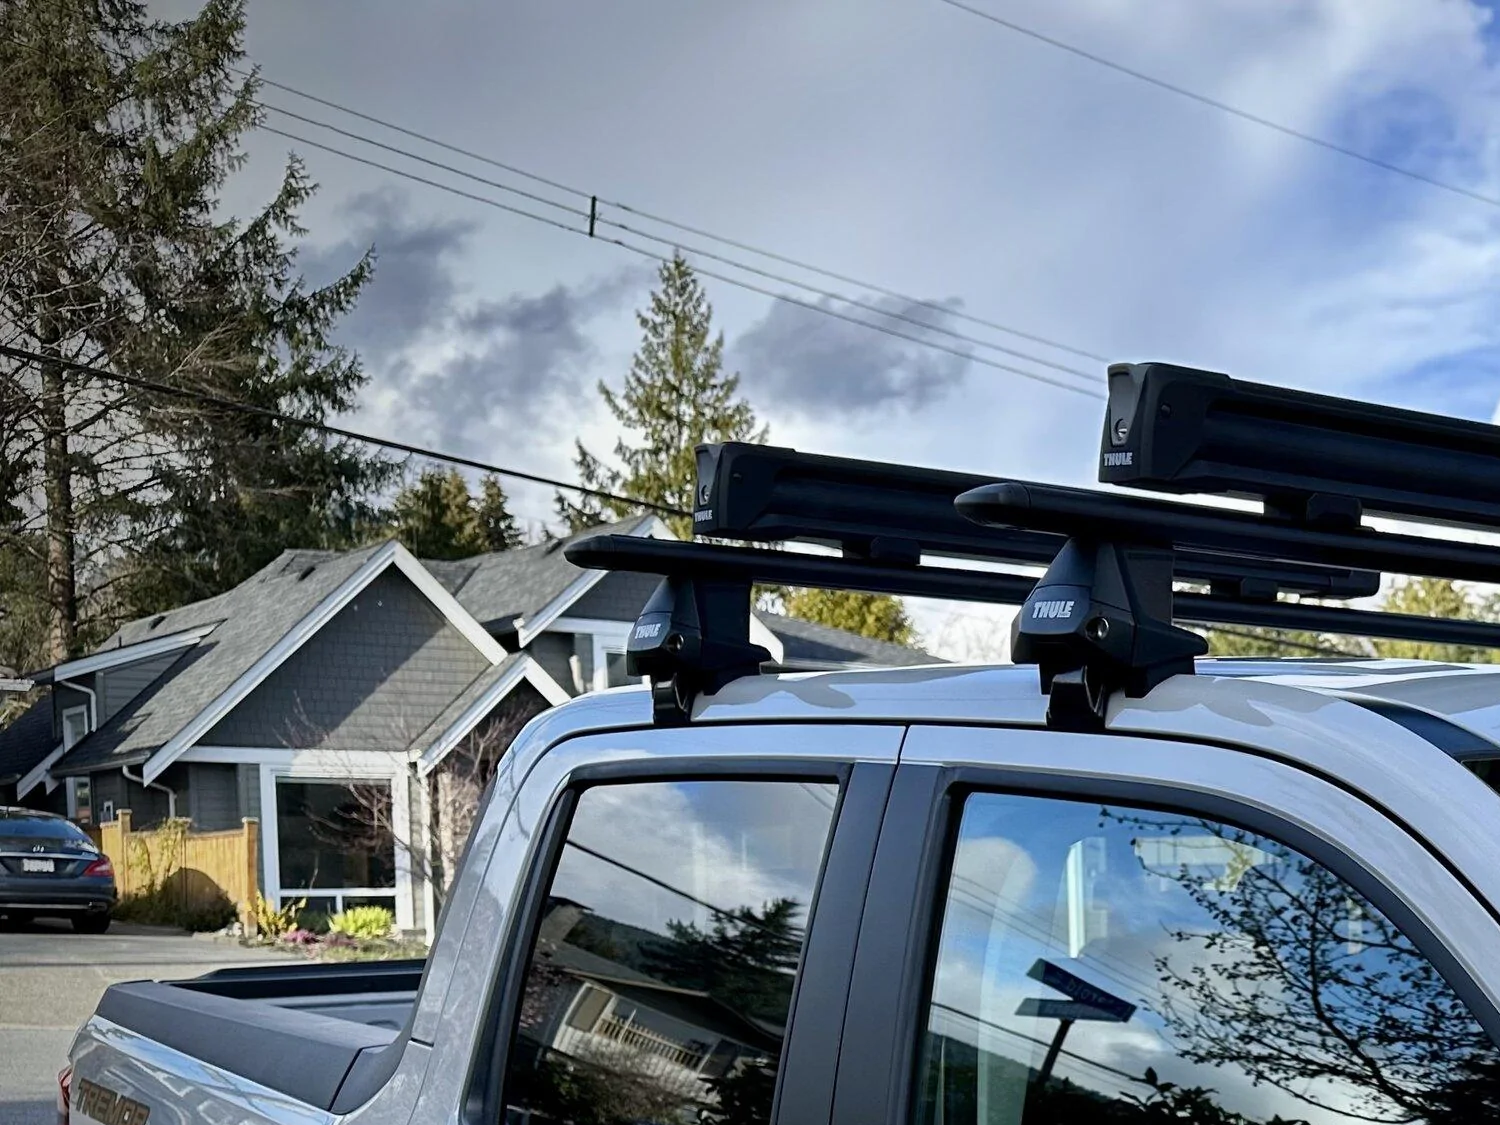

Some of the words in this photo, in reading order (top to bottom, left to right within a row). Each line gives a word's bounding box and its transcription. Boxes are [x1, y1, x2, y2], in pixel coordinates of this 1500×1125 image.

[1103, 452, 1133, 466] THULE
[694, 509, 713, 522] THULE
[1032, 600, 1075, 619] THULE
[634, 623, 662, 639] THULE
